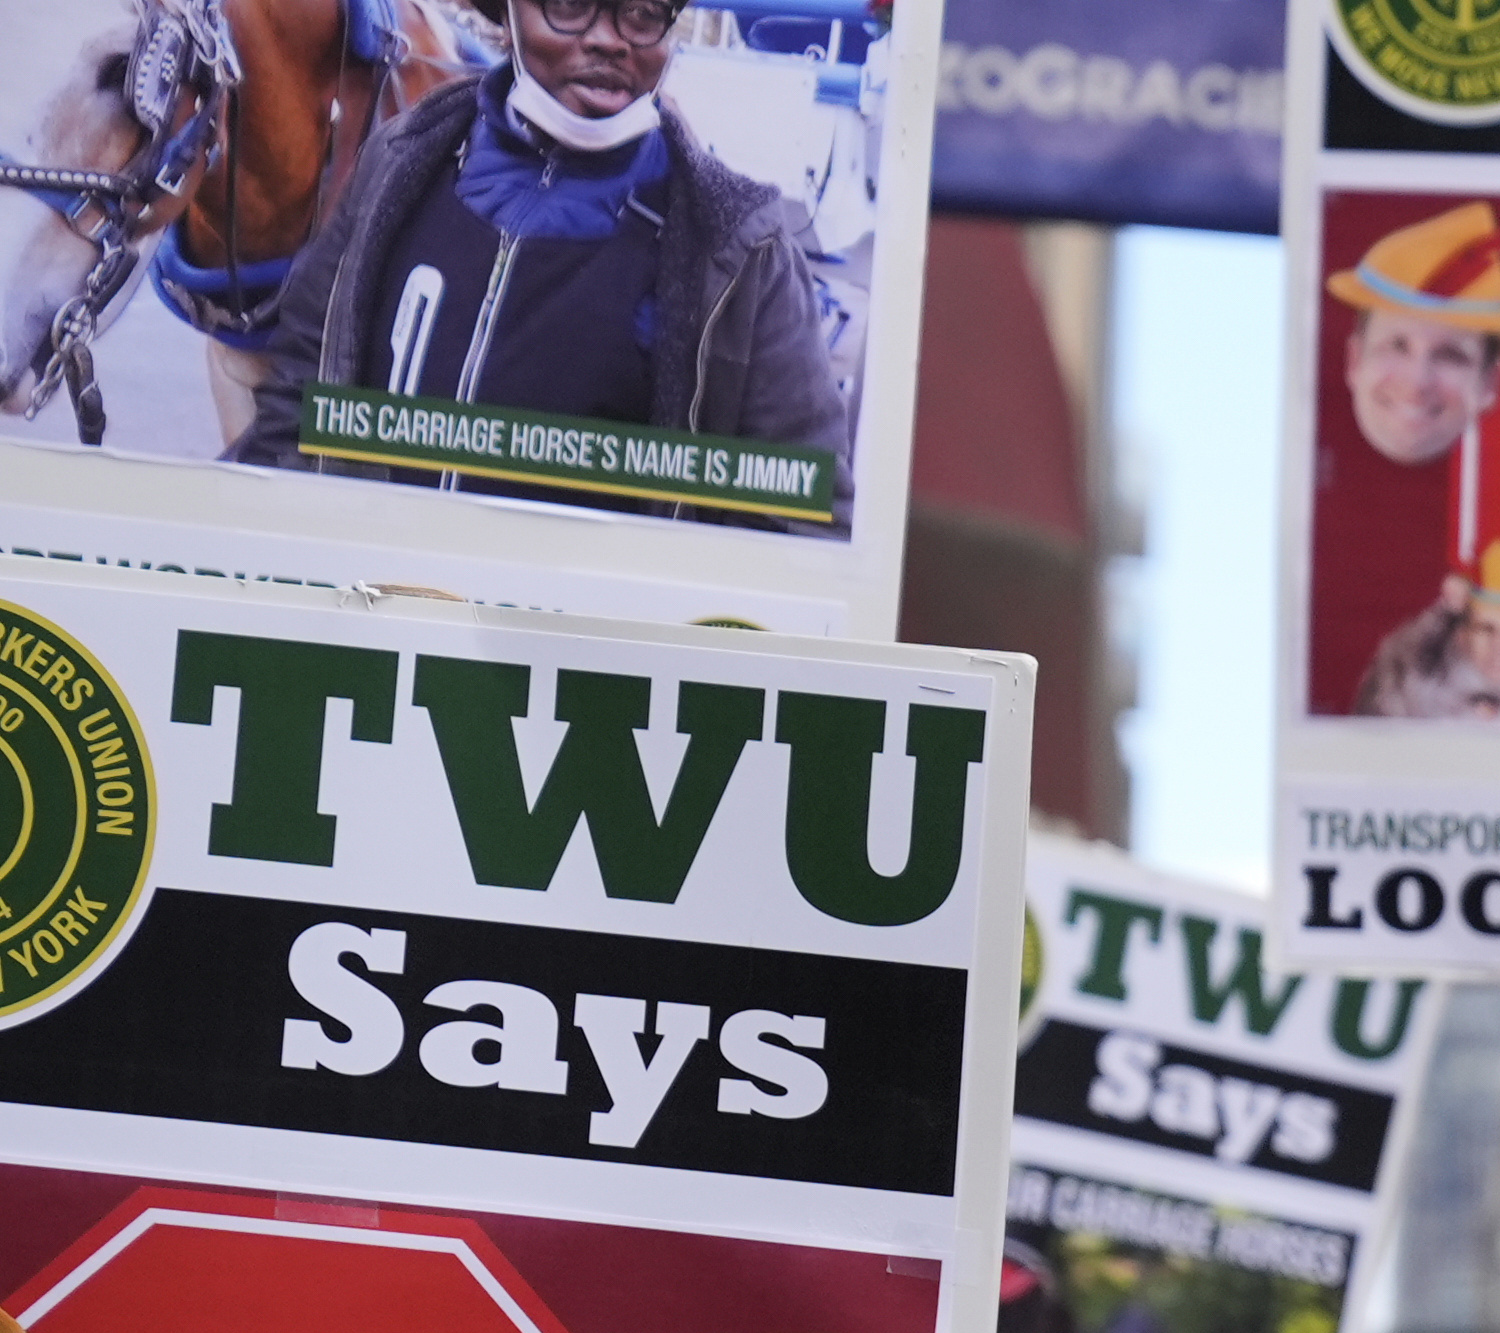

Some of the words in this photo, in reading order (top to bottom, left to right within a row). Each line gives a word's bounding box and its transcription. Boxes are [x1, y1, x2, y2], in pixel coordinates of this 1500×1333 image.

[313, 395, 371, 438] THIS
[377, 403, 503, 456] CARRIAGE
[510, 422, 618, 472] HORSE'S
[624, 438, 698, 483] NAME
[704, 448, 729, 486] IS
[733, 452, 818, 498] JIMMY
[170, 630, 986, 927] TWU
[281, 922, 828, 1148] Says
